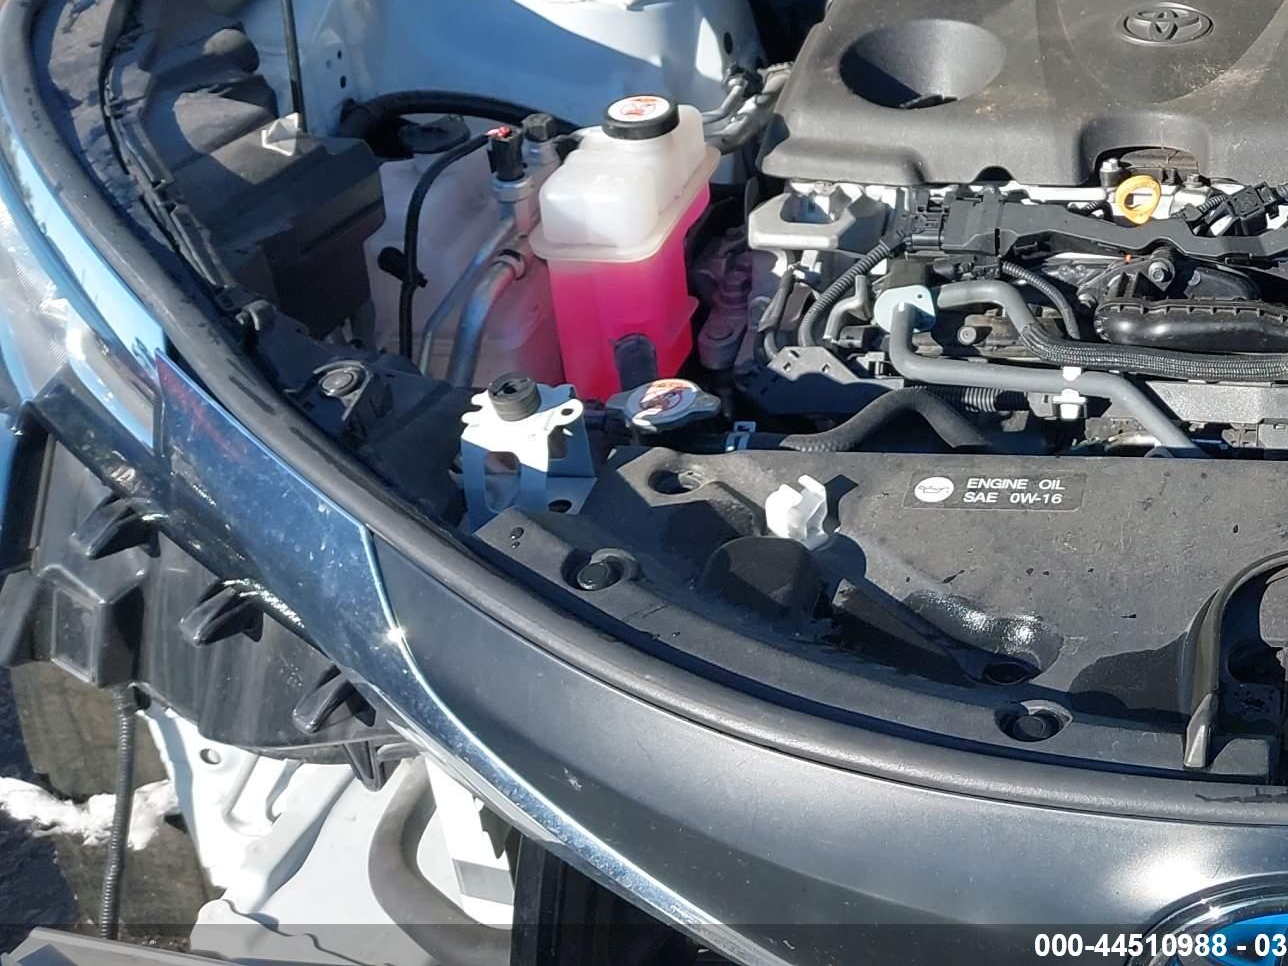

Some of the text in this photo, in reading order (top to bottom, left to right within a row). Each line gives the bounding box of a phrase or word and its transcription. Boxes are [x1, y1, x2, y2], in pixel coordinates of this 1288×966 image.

[967, 479, 1065, 489] ENGINE OIL
[964, 492, 1062, 503] SAE 0W-16
